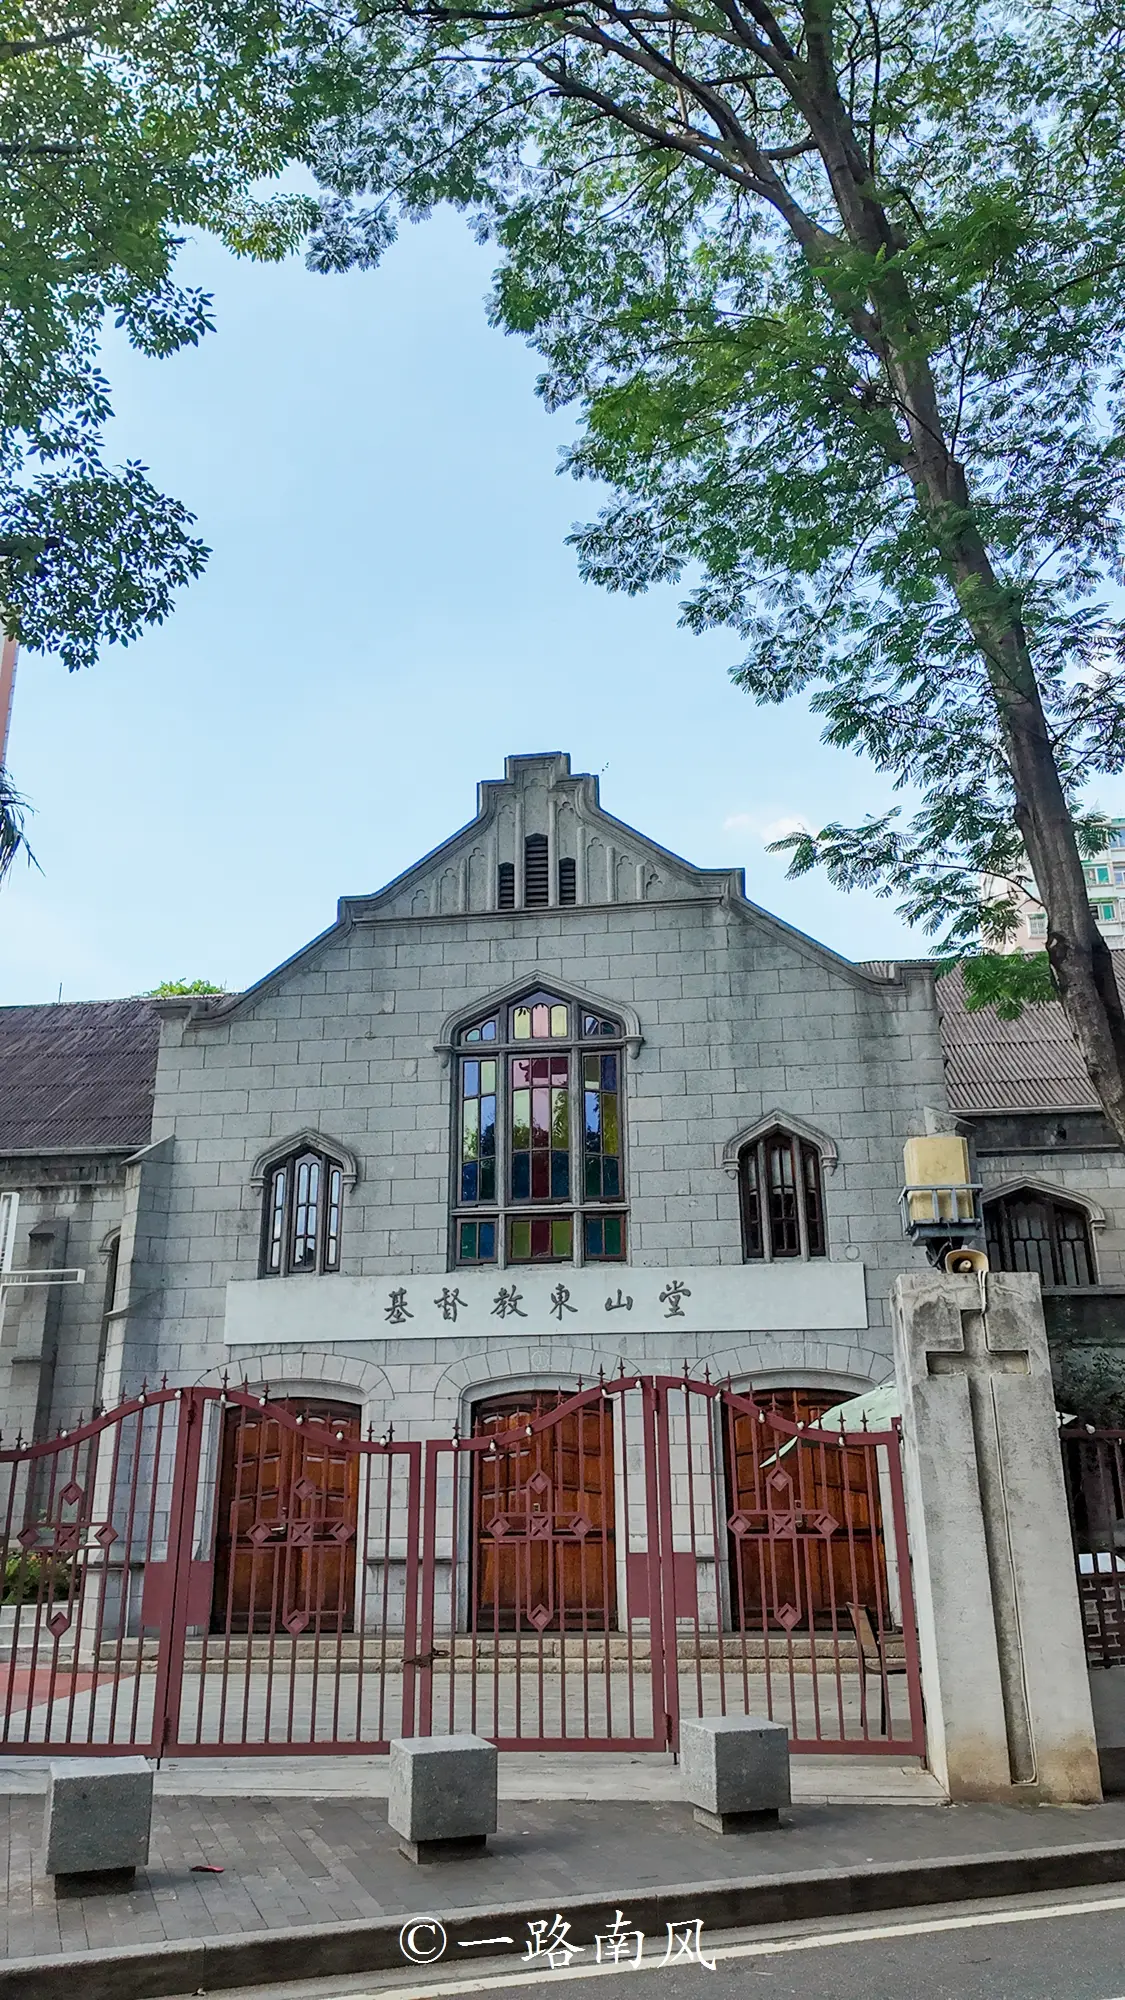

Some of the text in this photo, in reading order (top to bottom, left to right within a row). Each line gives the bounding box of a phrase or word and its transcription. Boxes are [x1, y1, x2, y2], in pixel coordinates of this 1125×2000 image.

[384, 1280, 691, 1325] 基督教東山堂
